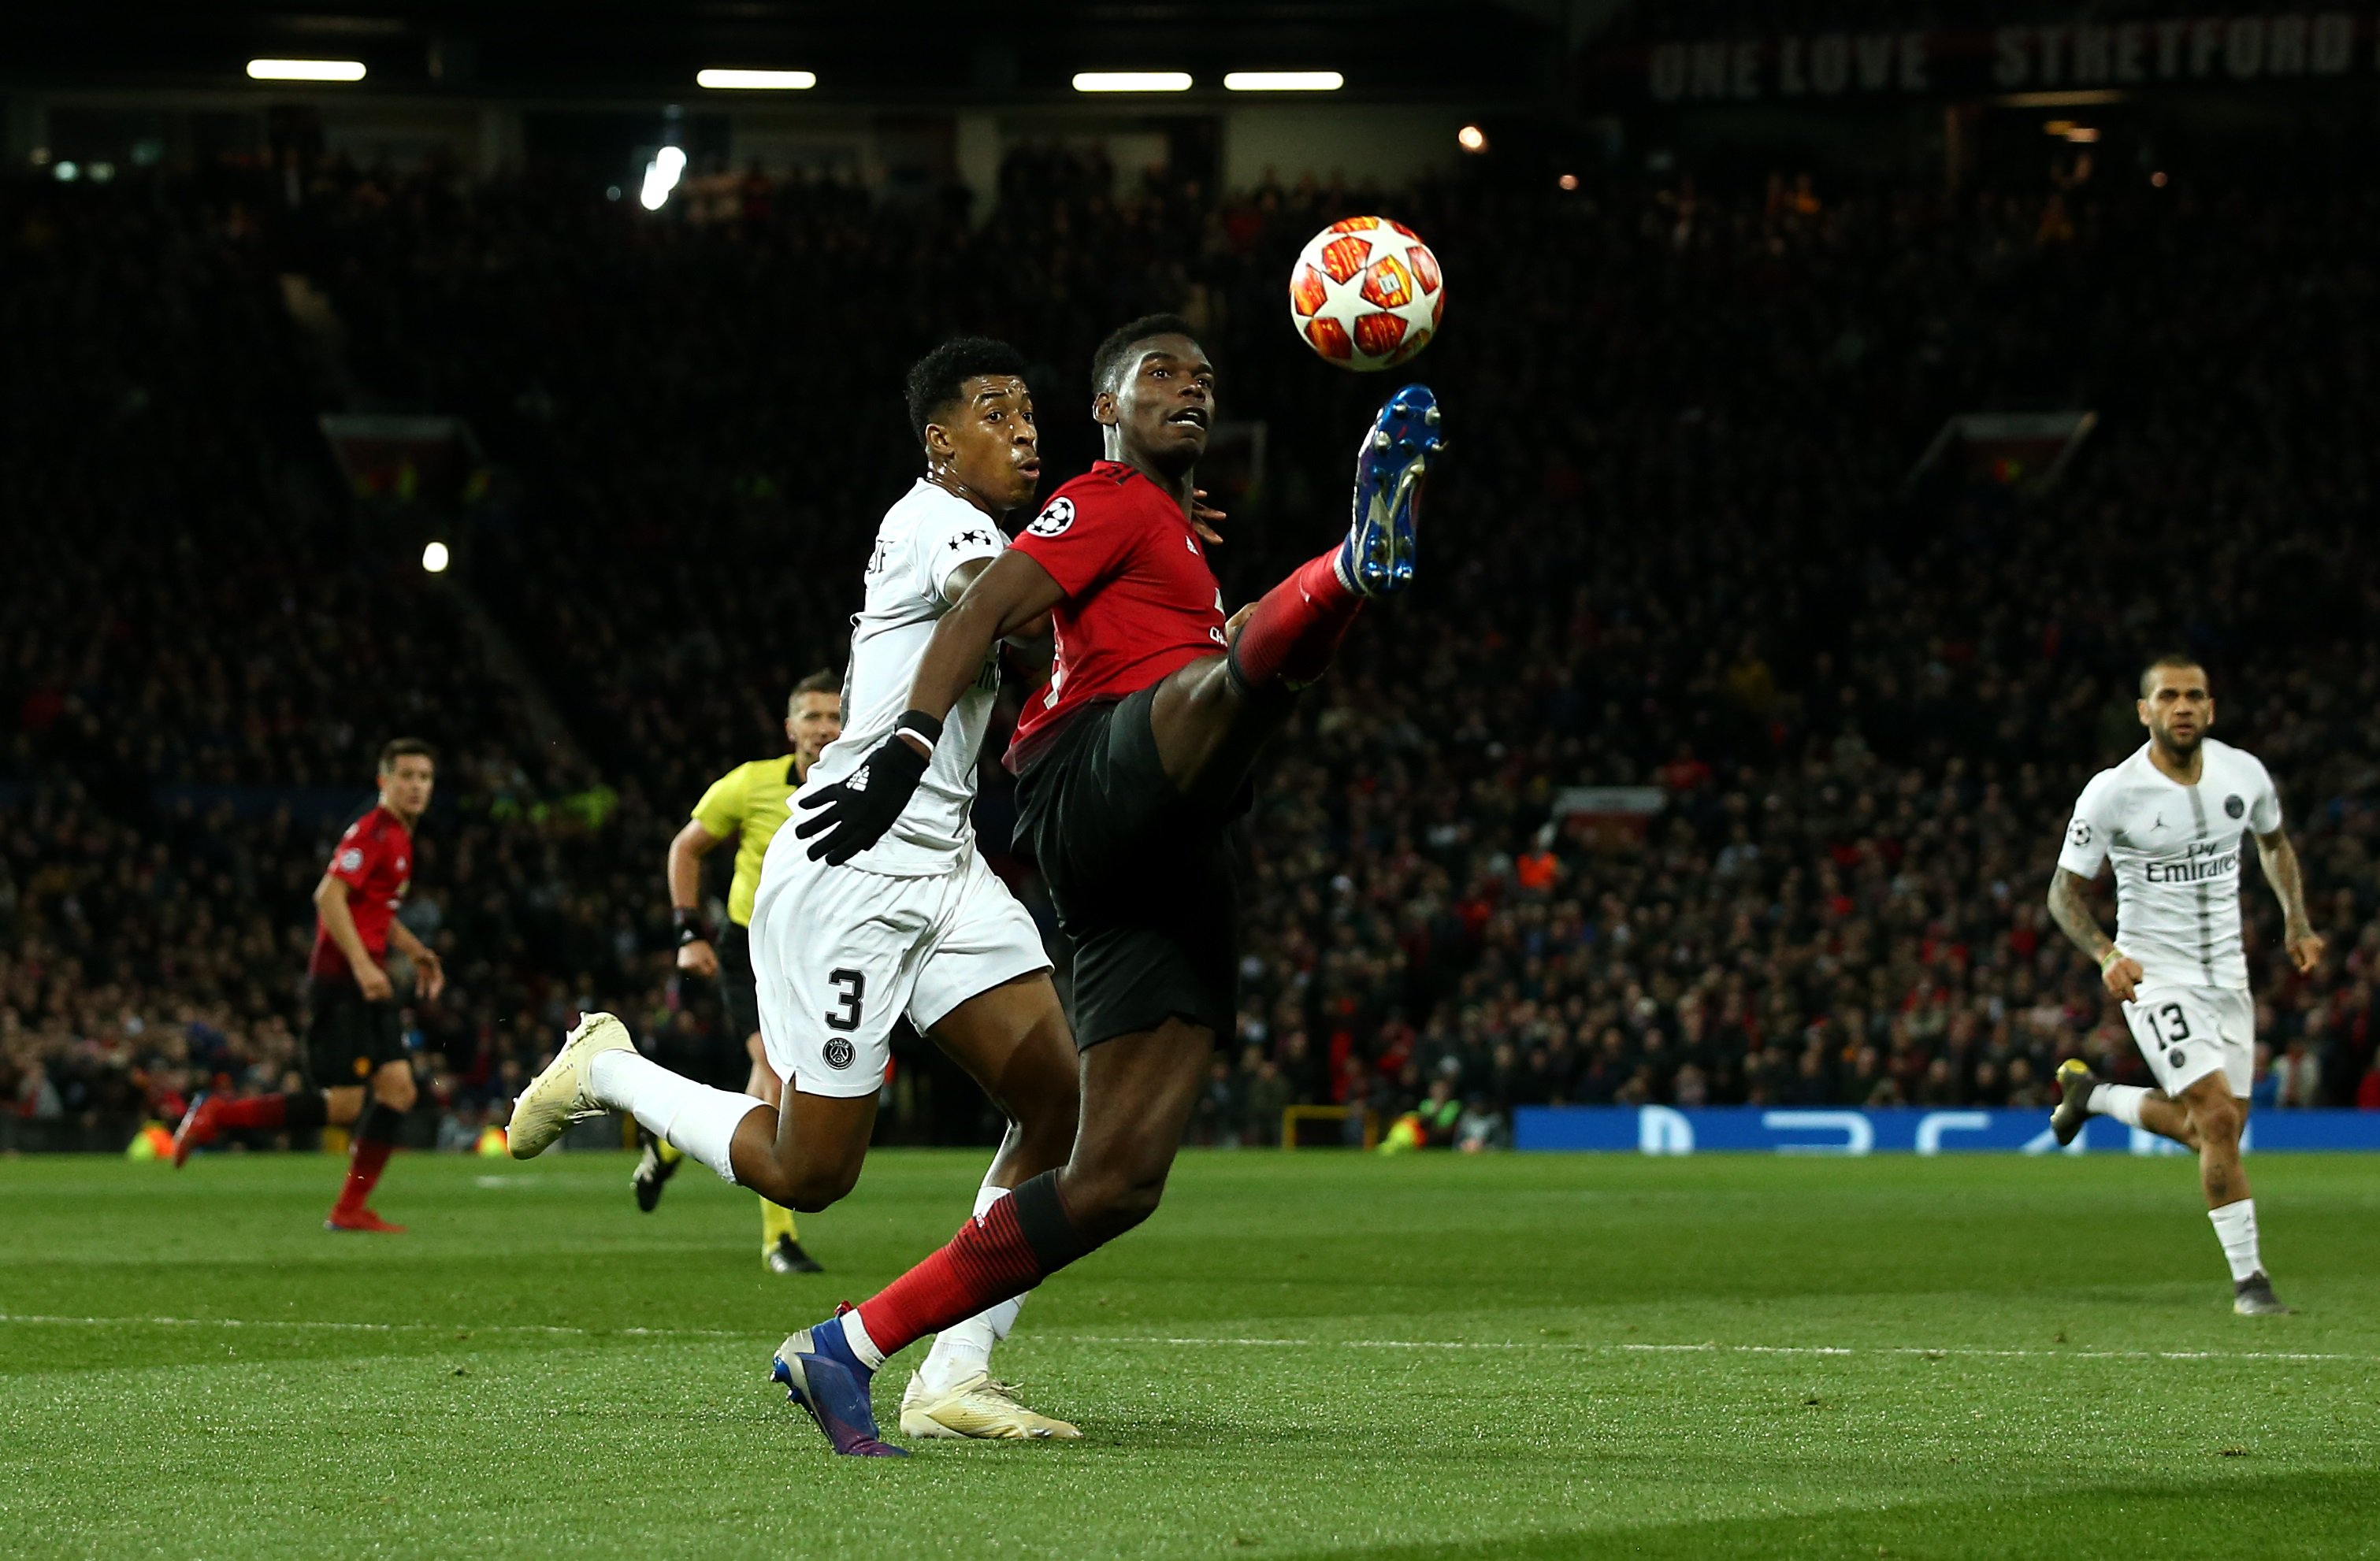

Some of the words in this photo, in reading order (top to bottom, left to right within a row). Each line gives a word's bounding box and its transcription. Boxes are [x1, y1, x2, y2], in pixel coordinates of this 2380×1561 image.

[1648, 40, 1762, 101] ONE
[1779, 31, 1929, 96] LOVE
[1992, 12, 2355, 86] STRETFORD
[2146, 854, 2237, 882] Emirate
[825, 967, 866, 1033] 3
[2148, 1003, 2190, 1051] 13
